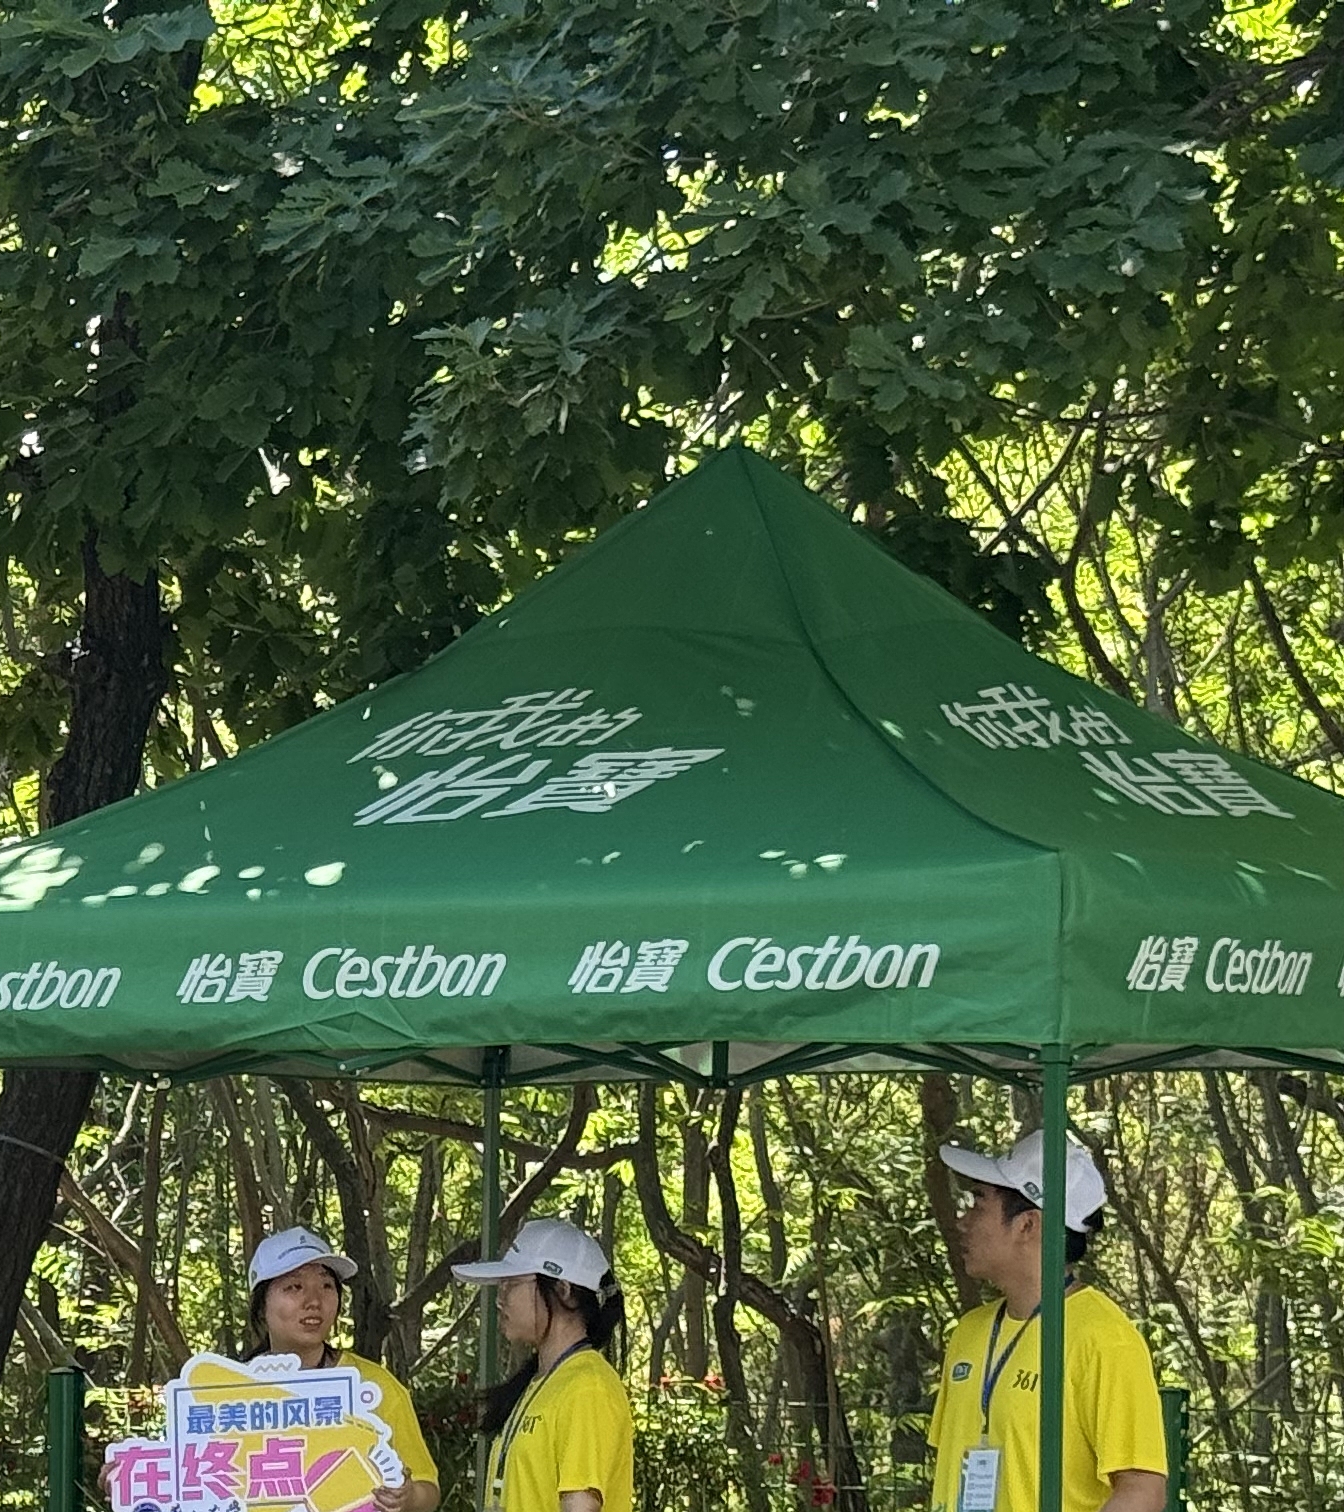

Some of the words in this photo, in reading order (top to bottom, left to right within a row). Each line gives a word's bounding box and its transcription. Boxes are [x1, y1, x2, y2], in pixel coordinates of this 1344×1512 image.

[352, 746, 726, 826] 怡寶
[1079, 748, 1297, 819] 怡寶
[175, 949, 284, 1004] 怡寶
[567, 938, 690, 994] 怡寶
[1125, 935, 1199, 993] 怡寶
[186, 1396, 343, 1433] 最美的风景
[113, 1438, 307, 1506] 在终点
